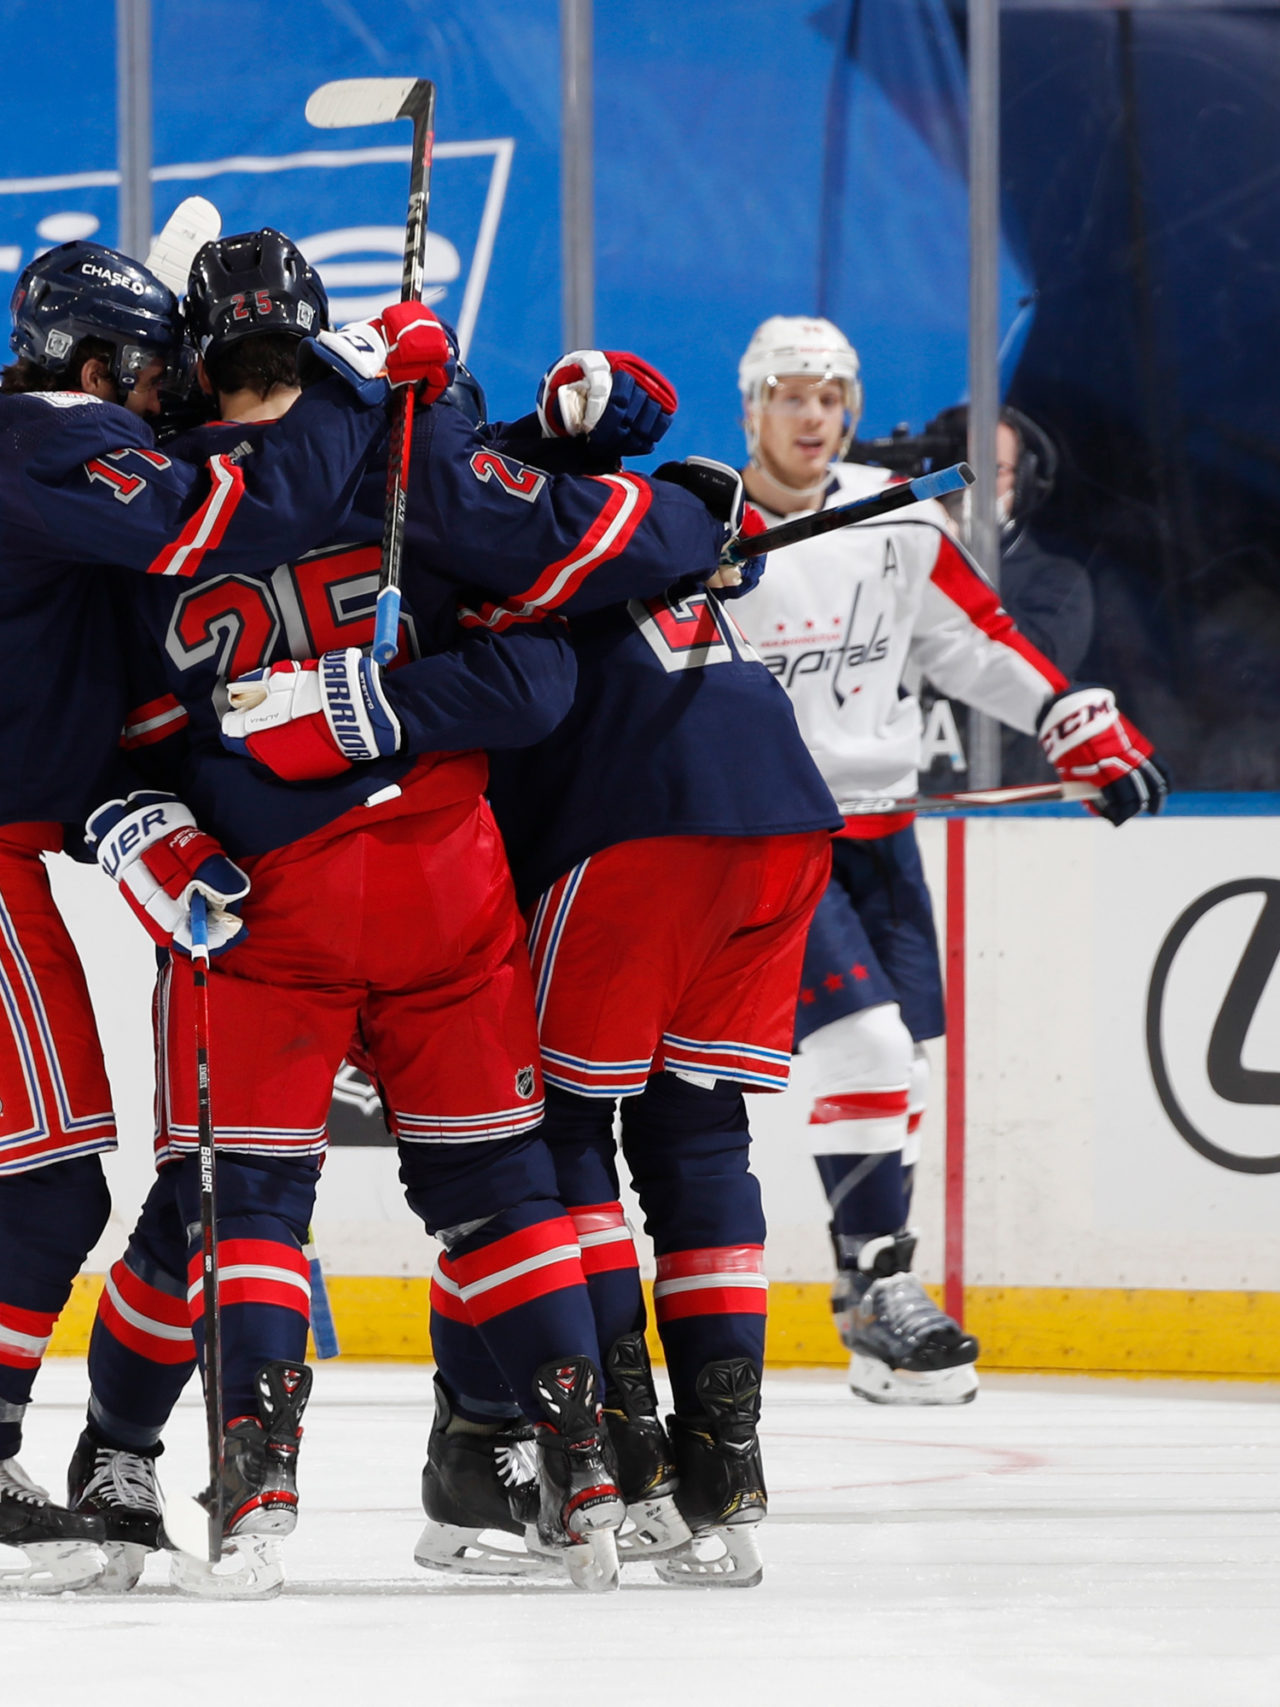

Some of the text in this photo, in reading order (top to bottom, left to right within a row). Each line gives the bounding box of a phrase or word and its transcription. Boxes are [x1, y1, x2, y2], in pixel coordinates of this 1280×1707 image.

[81, 262, 131, 289] CHASE
[230, 289, 273, 320] 25
[470, 445, 552, 503] 2
[882, 537, 898, 578] A
[762, 582, 889, 708] apitals
[101, 808, 168, 876] UER
